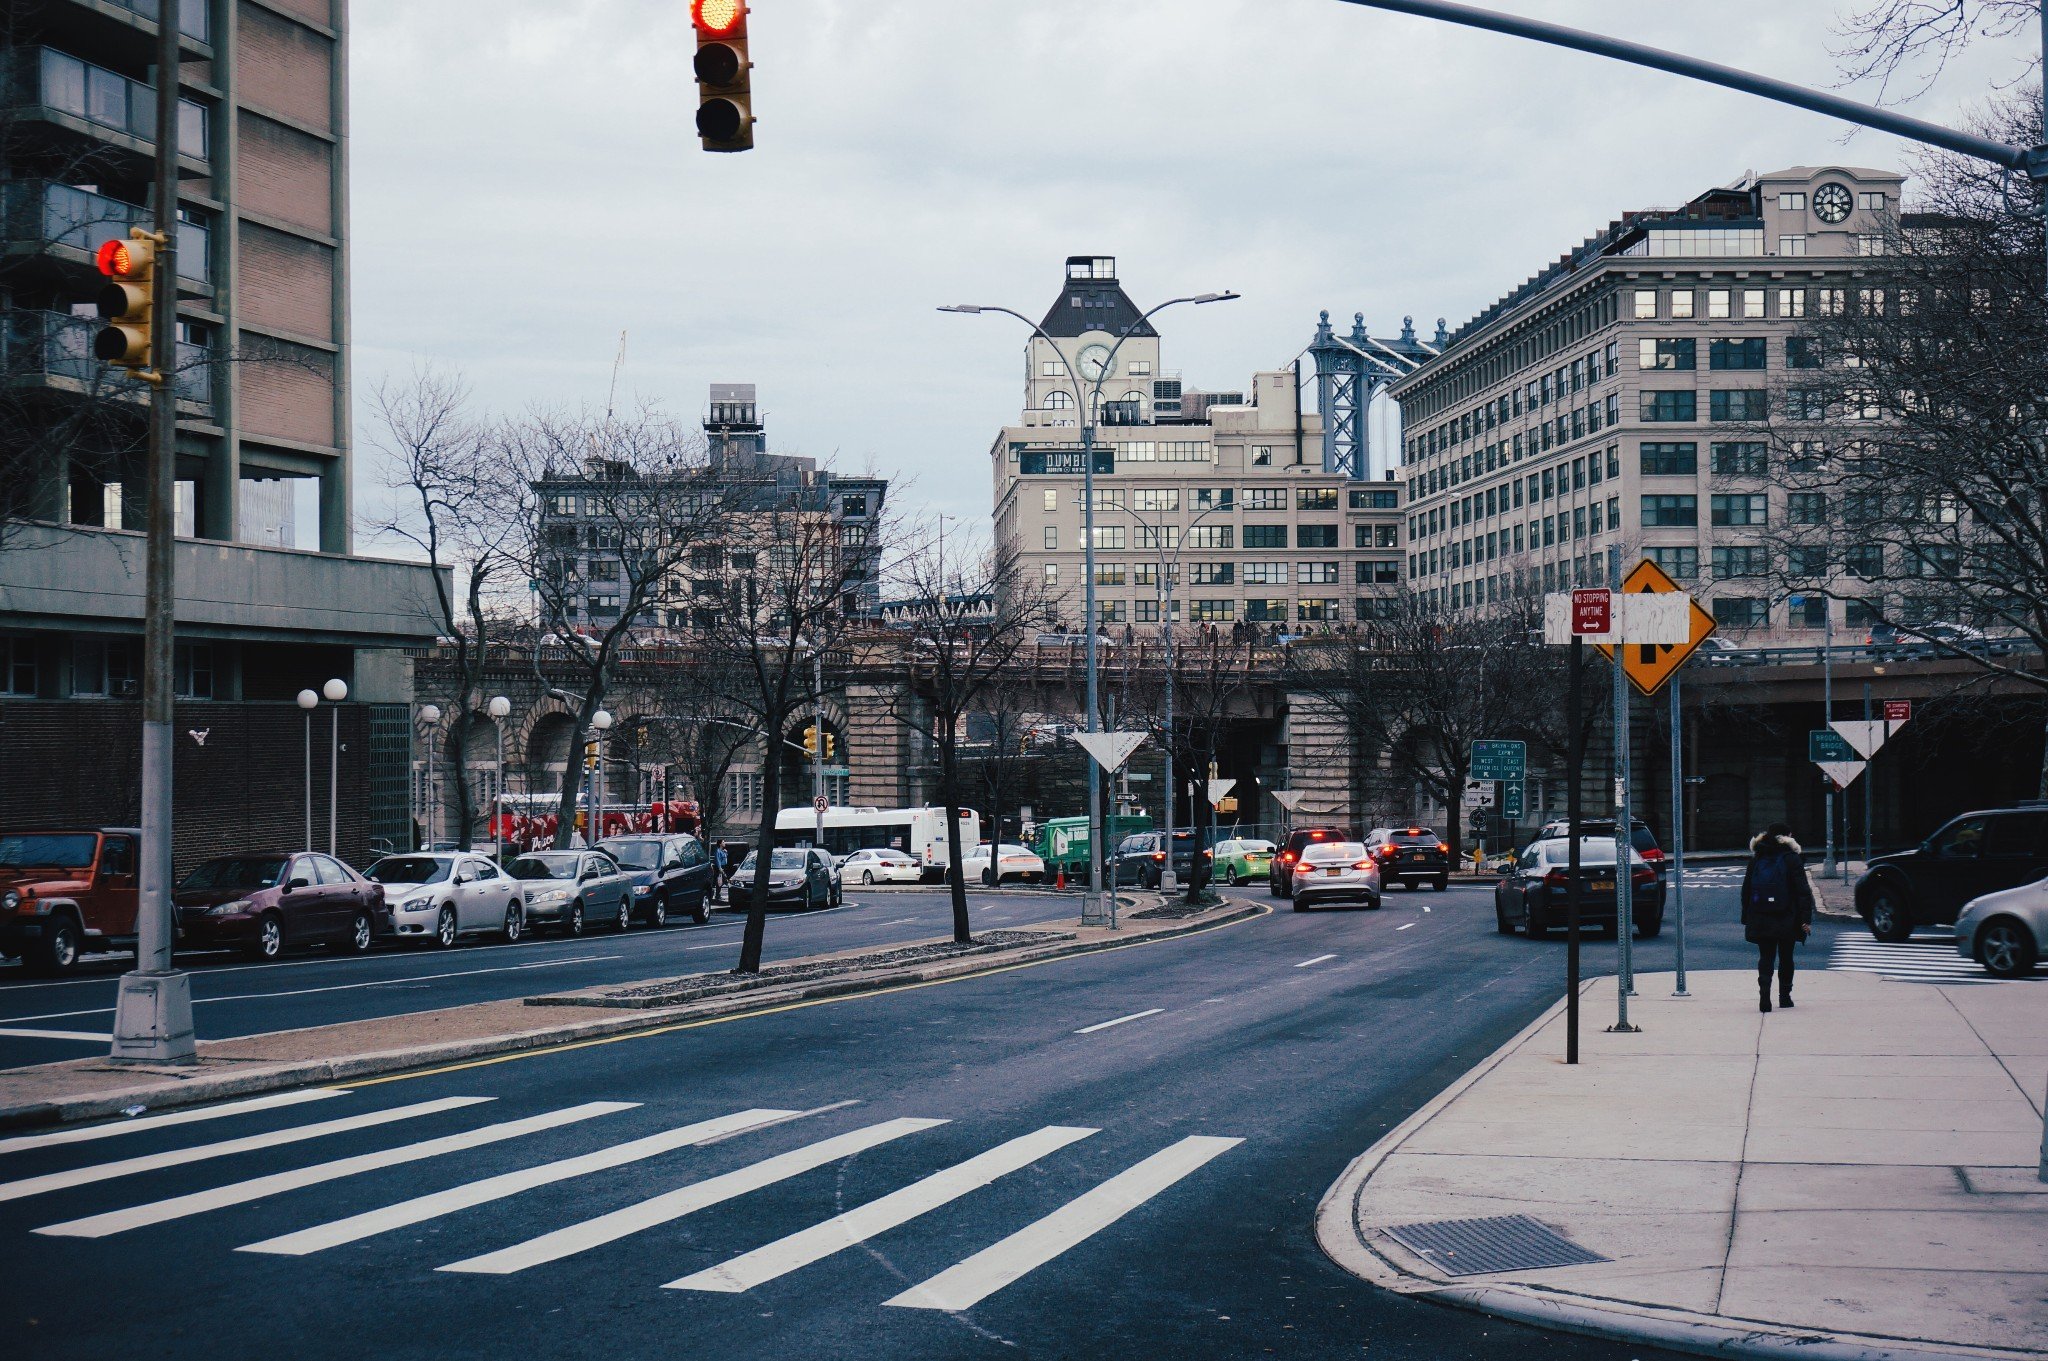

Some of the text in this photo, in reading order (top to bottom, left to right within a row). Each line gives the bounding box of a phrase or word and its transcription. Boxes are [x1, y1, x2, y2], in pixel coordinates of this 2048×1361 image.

[1574, 593, 1609, 603] NO STOPPING
[1580, 606, 1603, 616] ANYTIME
